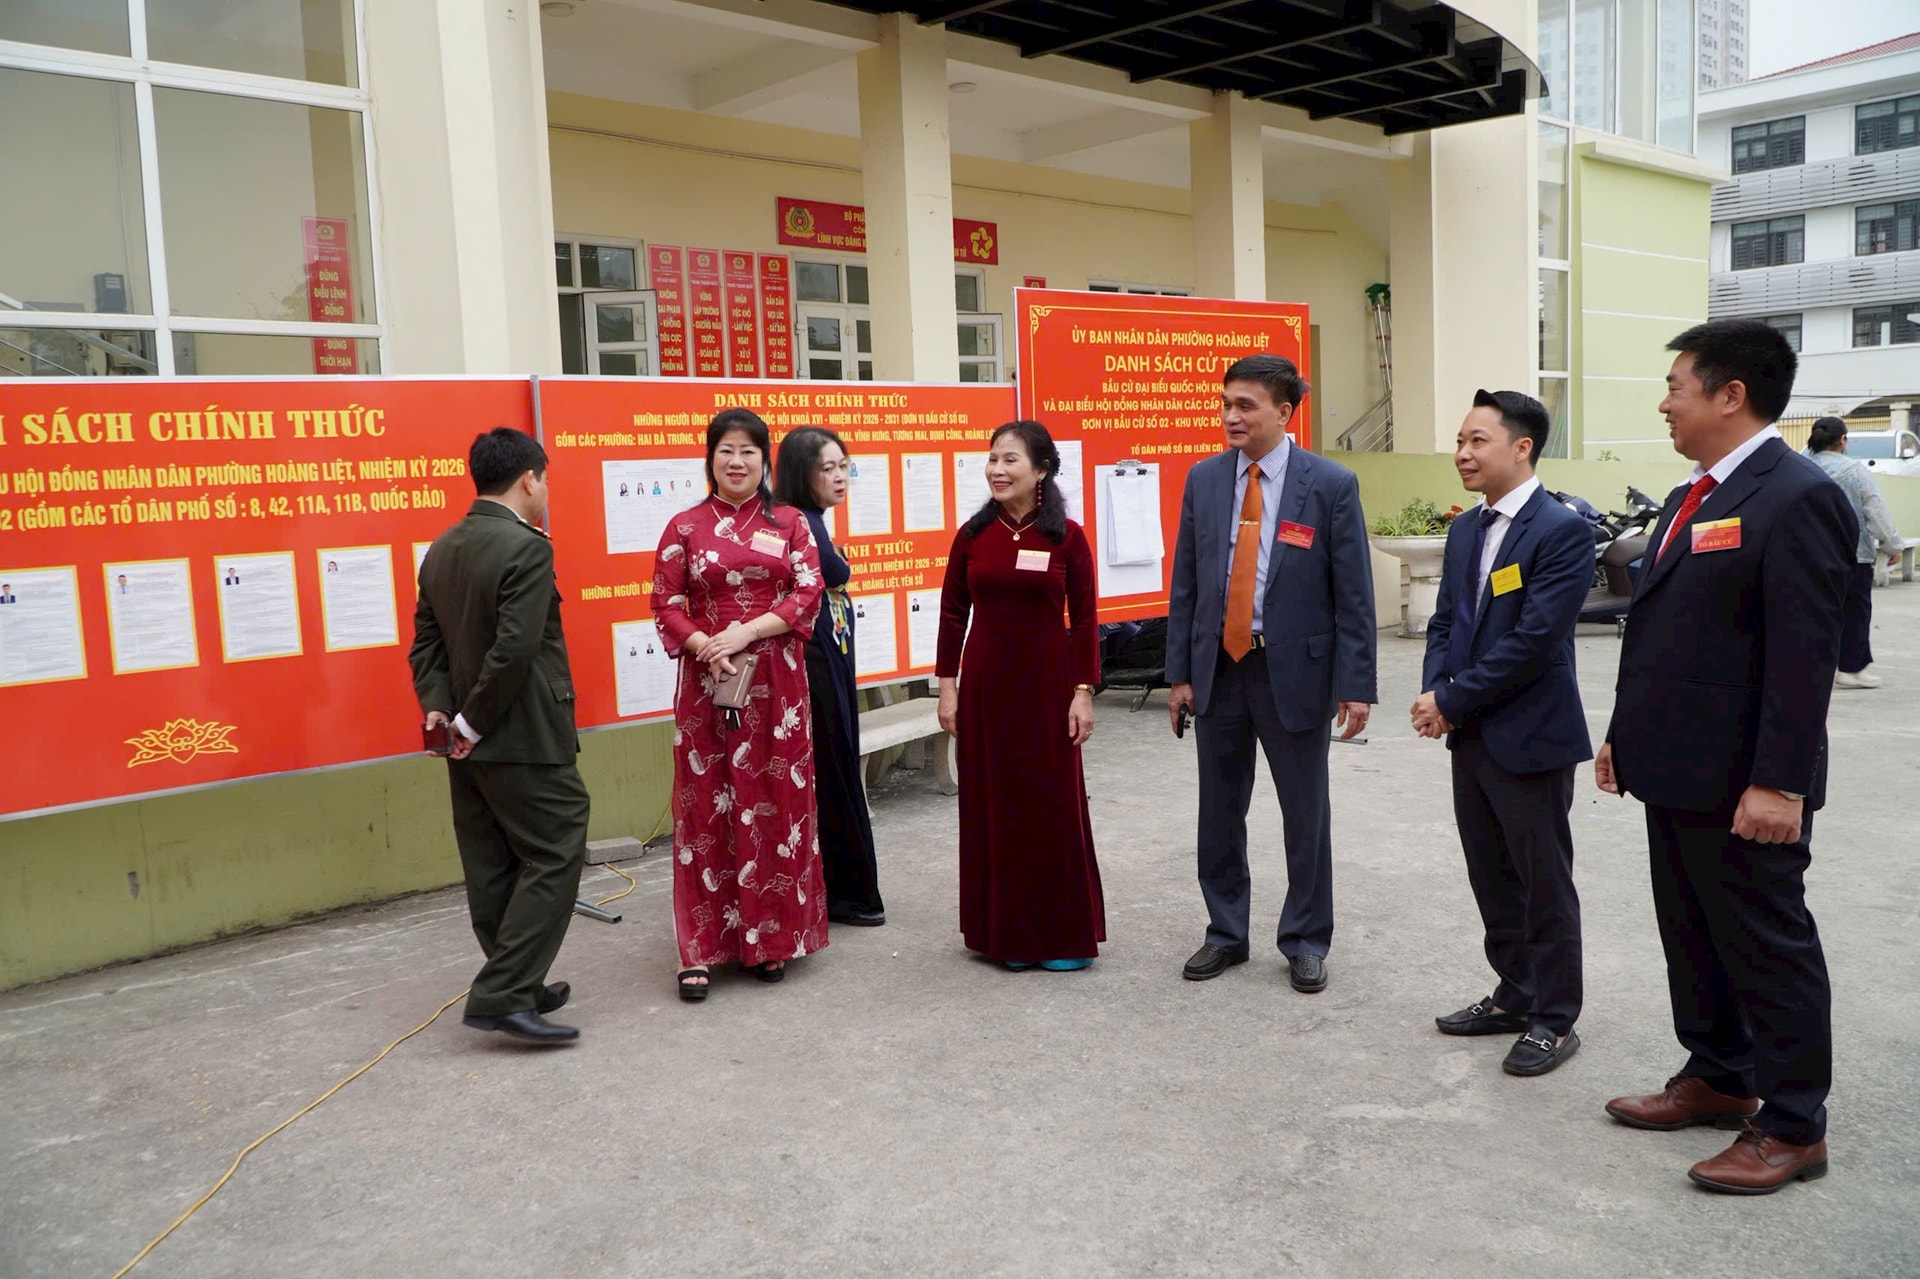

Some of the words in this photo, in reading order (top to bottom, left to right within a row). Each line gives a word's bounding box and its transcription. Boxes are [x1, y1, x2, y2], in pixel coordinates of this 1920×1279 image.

[319, 268, 339, 282] ĐÚNG
[314, 282, 328, 298] ĐIỀU
[330, 286, 346, 302] LỆNH
[659, 288, 677, 300] KHÔNG
[324, 303, 344, 316] ĐÚNG
[663, 317, 681, 328] KHÔNG
[1072, 324, 1086, 343] ỦY
[1090, 330, 1112, 344] BAN
[1114, 328, 1144, 344] NHÂN
[1147, 328, 1168, 346] DÂN
[1172, 330, 1214, 346] PHƯỜNG
[1216, 331, 1251, 347] HOÀNG
[1254, 332, 1270, 352] LIỆT
[664, 346, 682, 356] KHÔNG
[320, 354, 335, 367] THỜI
[336, 356, 352, 370] HẠN
[1105, 355, 1150, 372] DANH
[1154, 352, 1192, 373] SÁCH
[1196, 351, 1218, 373] CỬ
[1121, 379, 1134, 393] CỬ
[1135, 382, 1150, 396] ĐẠI
[1152, 378, 1168, 393] BIỂU
[1170, 379, 1194, 393] QUỐC
[1196, 380, 1210, 396] HỘI
[714, 394, 762, 408] DANH
[768, 391, 810, 408] SÁCH
[815, 392, 864, 408] CHÍNH
[868, 392, 908, 408] THỨC
[1044, 398, 1056, 412] VÀ
[1058, 401, 1074, 415] ĐẠI
[1076, 395, 1094, 412] BIỂU
[1096, 398, 1112, 415] HỘI
[1114, 396, 1139, 412] ĐỒNG
[1141, 398, 1164, 411] NHÂN
[1166, 398, 1182, 411] DÂN
[1184, 398, 1202, 411] CÁC
[1204, 396, 1220, 410] CẤP
[22, 406, 135, 444] SÁCH
[148, 404, 276, 441] CHÍNH
[286, 404, 386, 438] THỨC
[634, 412, 662, 426] NHỮNG
[665, 411, 690, 426] NGƯỜI
[692, 412, 708, 426] ỨNG
[777, 411, 790, 428] HỘI
[812, 414, 822, 424] XVI
[829, 412, 851, 427] NHIỆM
[863, 414, 879, 424] 2026
[884, 414, 899, 424] 2031
[918, 414, 925, 426] VỊ
[948, 410, 958, 424] SỐ
[1082, 418, 1101, 430] ĐƠN
[1104, 419, 1112, 432] VỊ
[1132, 416, 1145, 428] CỬ
[1146, 414, 1158, 428] SỐ
[1160, 418, 1169, 428] 02
[1176, 418, 1191, 428] KHU
[1193, 417, 1209, 430] VỰC
[578, 432, 597, 446] CÁC
[638, 433, 652, 446] HAI
[13, 468, 45, 498] HỘI
[48, 464, 99, 492] ĐỒNG
[103, 464, 152, 490] NHÂN
[156, 463, 192, 488] DÂN
[195, 460, 262, 486] PHƯỜNG
[265, 459, 319, 484] HOÀNG
[322, 458, 356, 484] LIỆT,
[359, 456, 407, 483] NHIỆM
[410, 455, 428, 478] KỲ
[432, 458, 465, 477] 2026
[17, 500, 66, 532] (GỒM
[70, 501, 106, 526] CÁC
[110, 496, 132, 524] TỔ
[136, 498, 172, 523] DÂN
[176, 492, 210, 520] PHỐ
[214, 492, 237, 519] SỐ
[250, 498, 265, 519] 8,
[269, 496, 294, 518] 42,
[296, 495, 330, 516] 11A,
[334, 494, 367, 514] 11B,
[370, 484, 408, 512] QUỐC
[412, 484, 446, 509] BẢO)
[874, 540, 914, 556] THỨC
[582, 586, 612, 600] NHỮNG
[614, 582, 640, 597] NGƯỜI
